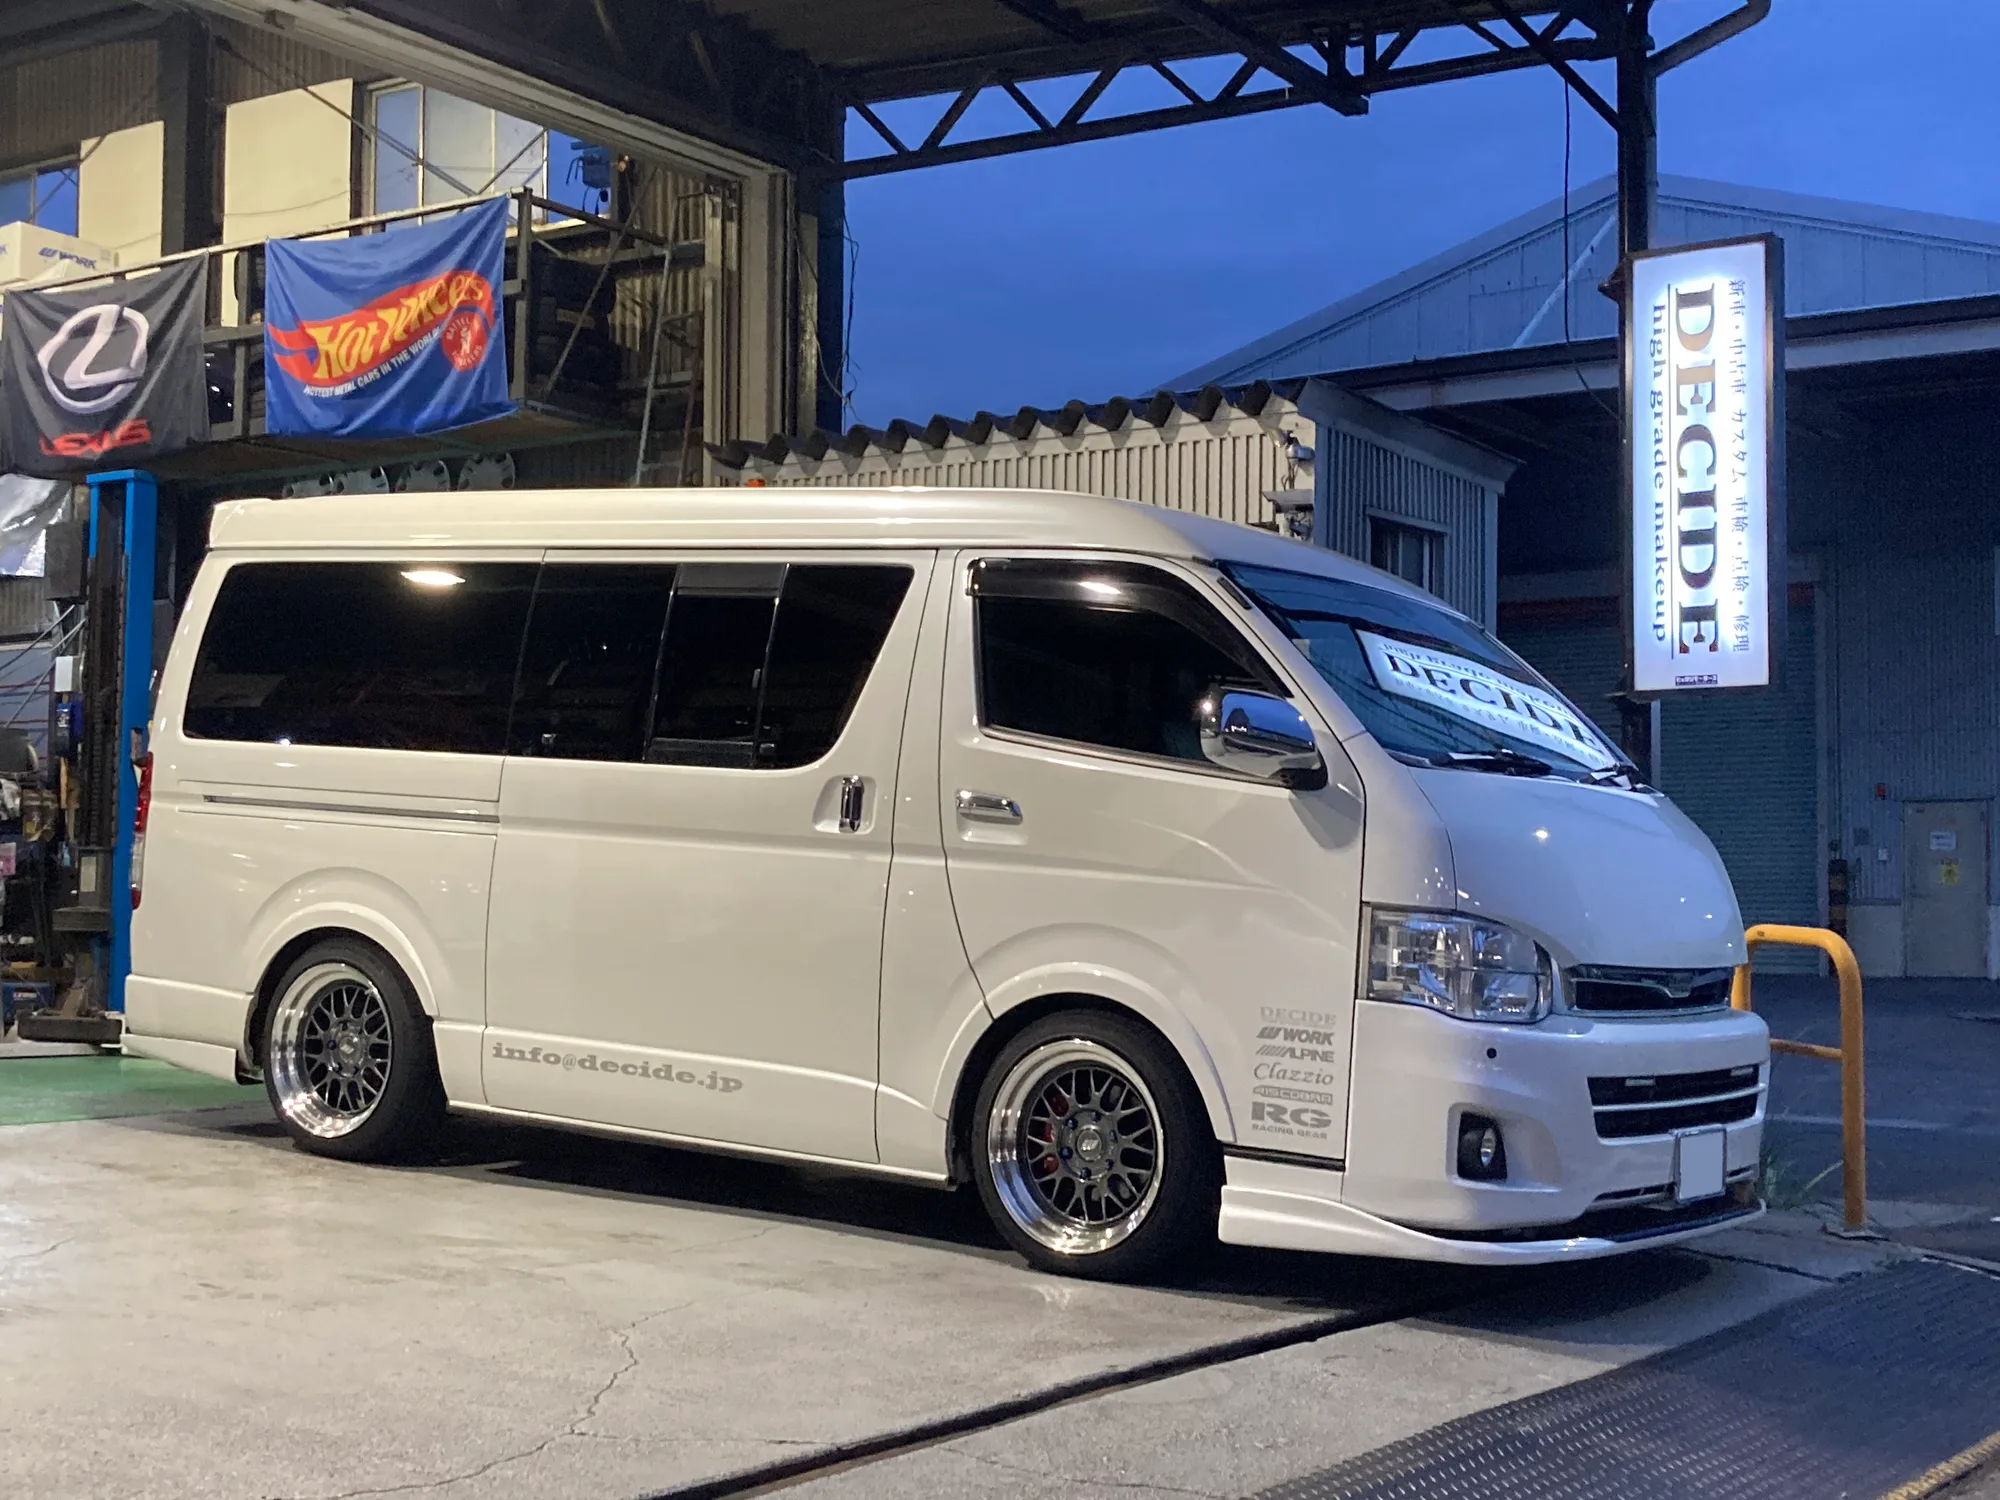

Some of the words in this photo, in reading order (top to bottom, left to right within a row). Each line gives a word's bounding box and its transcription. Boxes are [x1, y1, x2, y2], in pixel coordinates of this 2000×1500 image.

[1650, 304, 1667, 380] high
[357, 367, 381, 387] CARS
[379, 362, 392, 377] IN
[390, 349, 411, 369] THE
[1650, 389, 1668, 490] grade
[1730, 408, 1748, 484] カスタム
[1675, 282, 1719, 654] DECIDE
[1652, 501, 1668, 643] makeup
[1260, 1006, 1337, 1026] DECIDE
[1279, 1046, 1335, 1063] ALPINE
[1282, 1027, 1336, 1047] WORK
[492, 1042, 744, 1094] info@decide.jp
[1253, 1061, 1335, 1086] Clazzio
[1251, 1101, 1333, 1129] RG
[1251, 1123, 1294, 1136] RACING
[1296, 1128, 1329, 1140] GEAR
